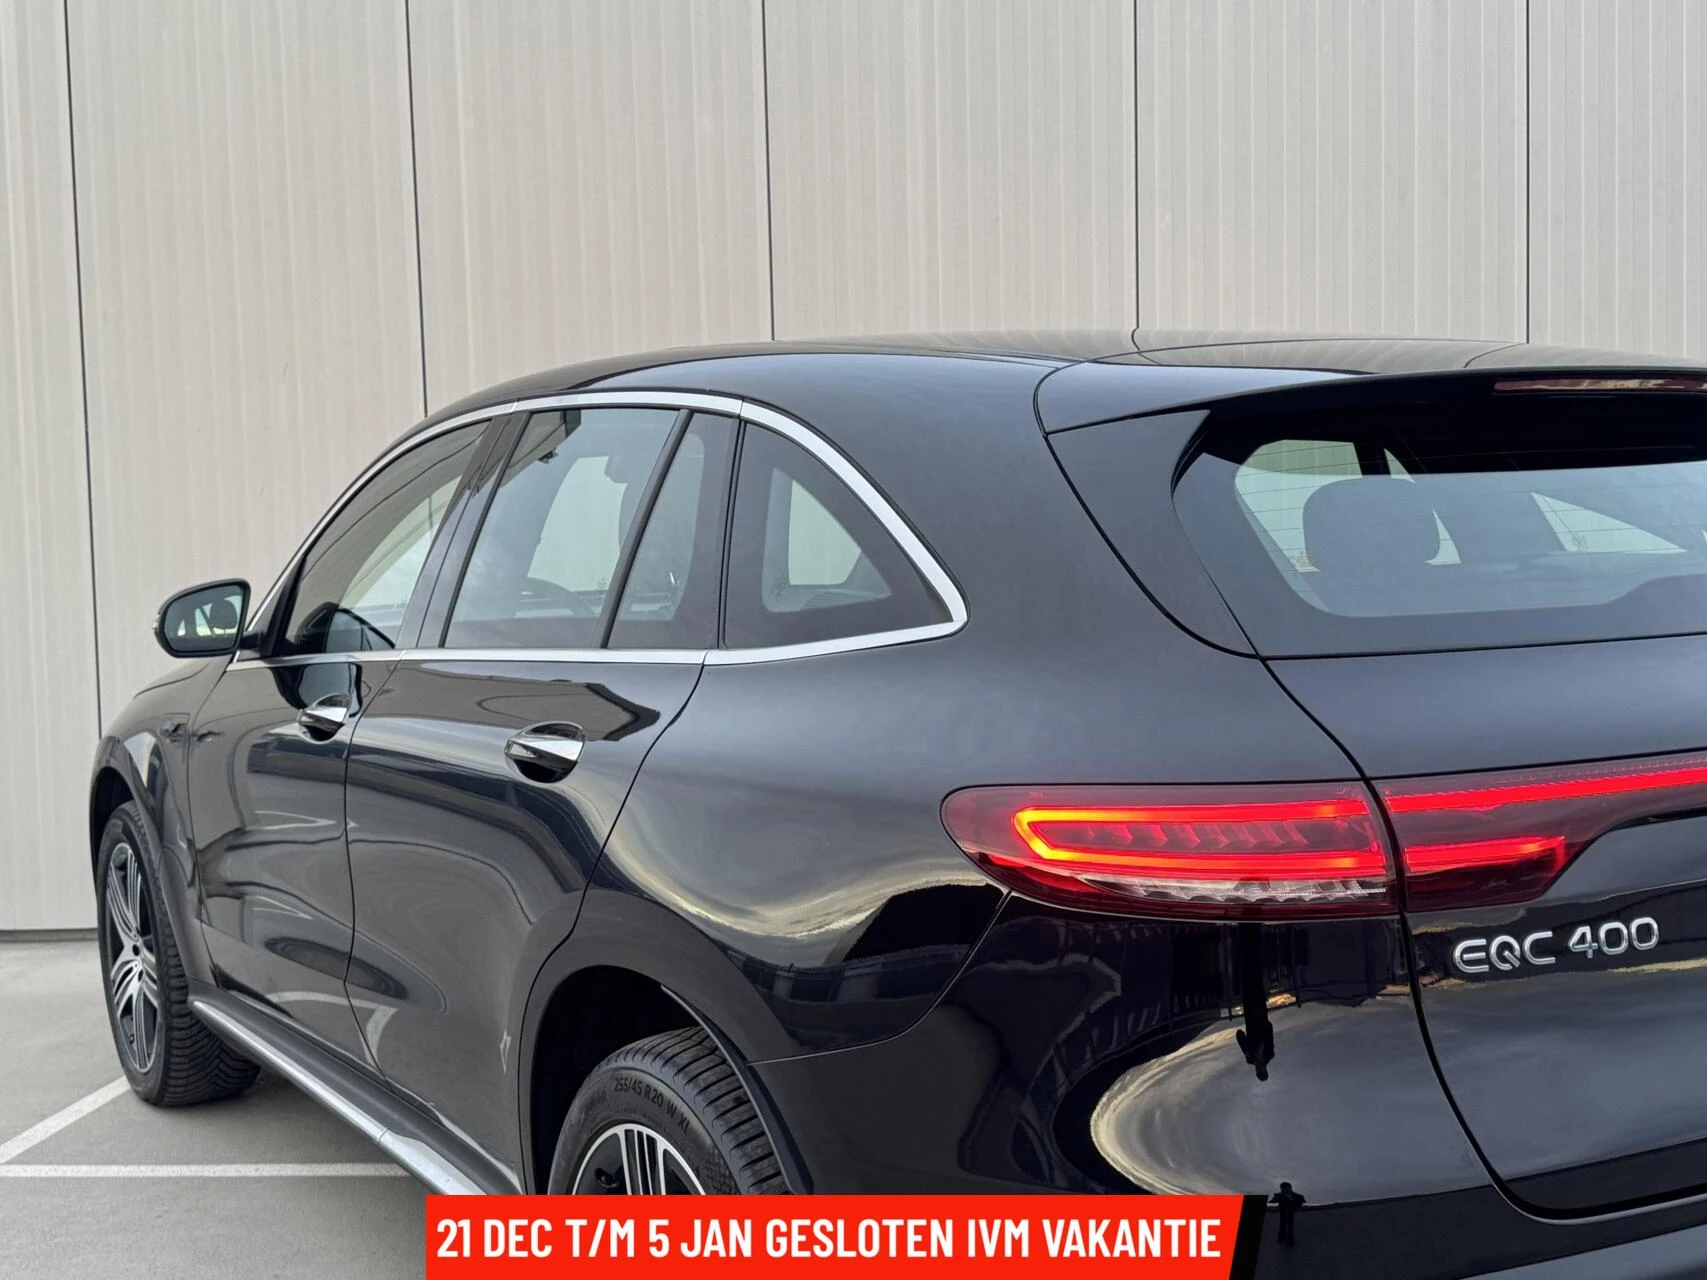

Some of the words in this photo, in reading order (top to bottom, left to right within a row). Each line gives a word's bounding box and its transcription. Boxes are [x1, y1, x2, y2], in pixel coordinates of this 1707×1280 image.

[1452, 931, 1556, 974] EQC
[1567, 916, 1660, 959] 400
[614, 1077, 643, 1096] 255/45
[666, 1100, 677, 1119] W
[678, 1113, 690, 1136] XL
